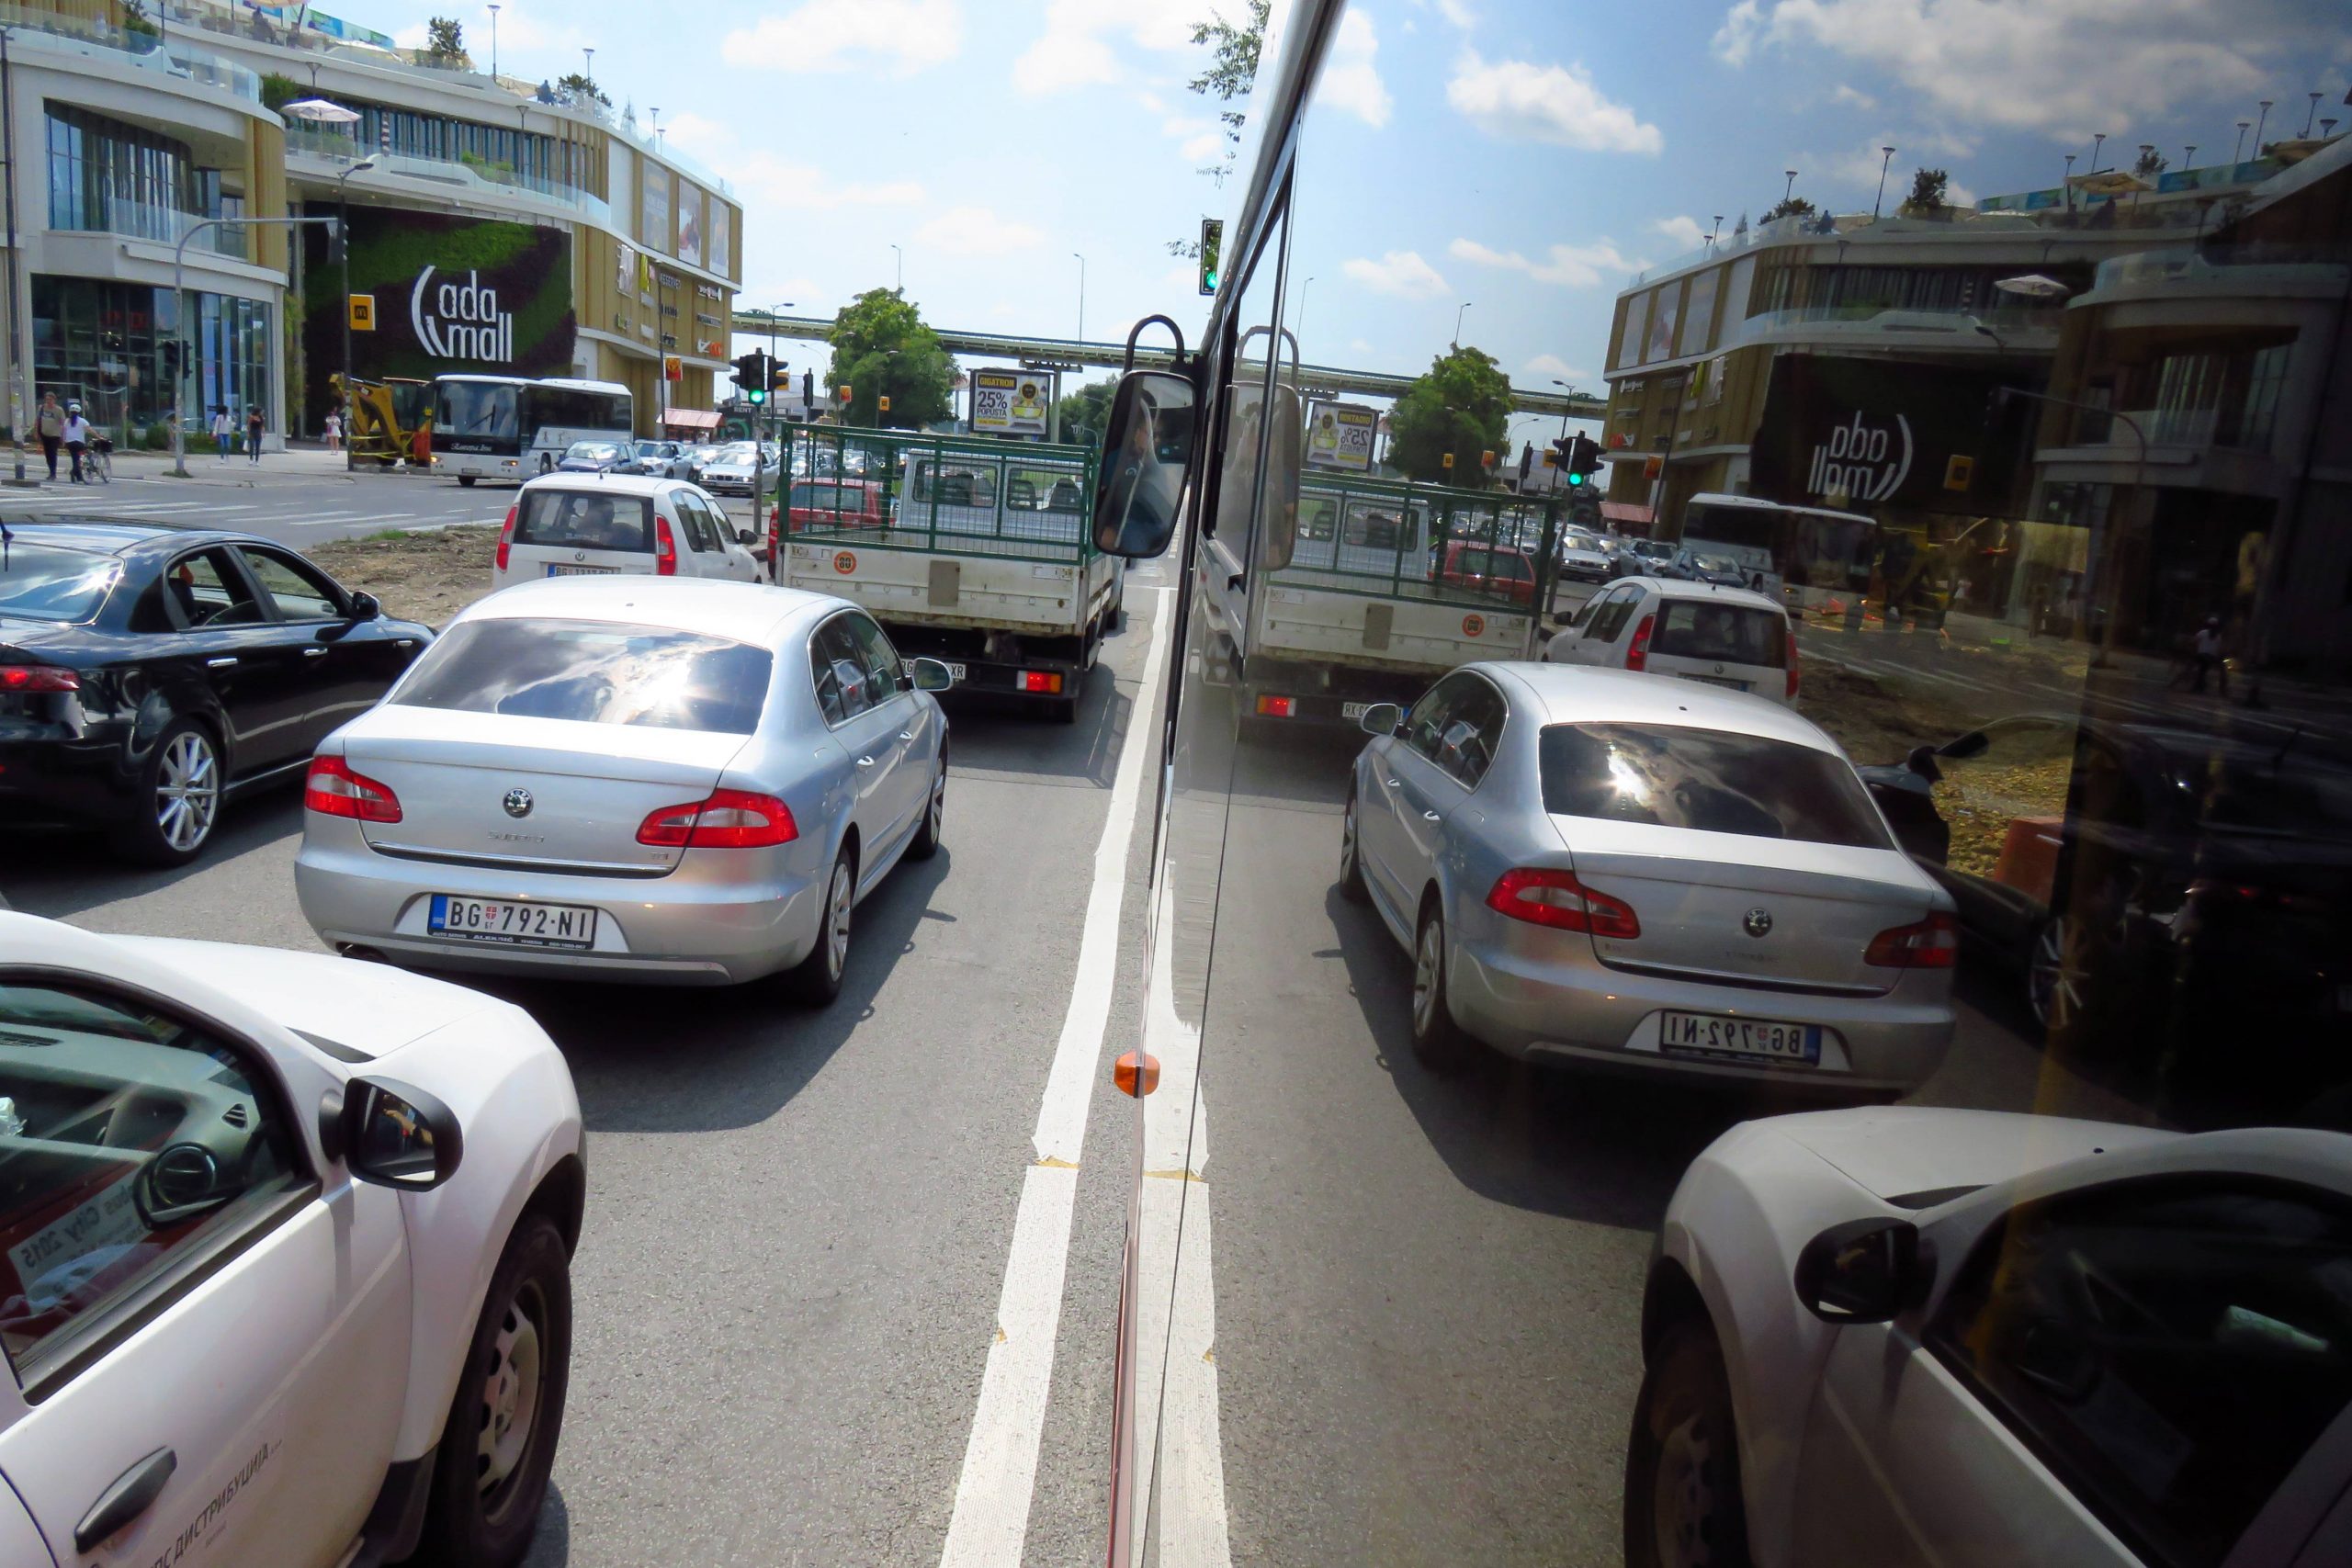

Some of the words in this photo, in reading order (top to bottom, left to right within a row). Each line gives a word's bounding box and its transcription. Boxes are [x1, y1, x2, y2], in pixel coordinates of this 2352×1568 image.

[439, 269, 497, 322] ada
[447, 312, 513, 363] mall
[979, 377, 1015, 388] GIGATRON
[978, 390, 1008, 410] 25%
[977, 407, 1007, 417] POPUSTA
[951, 664, 964, 678] XR
[450, 901, 481, 928] BG
